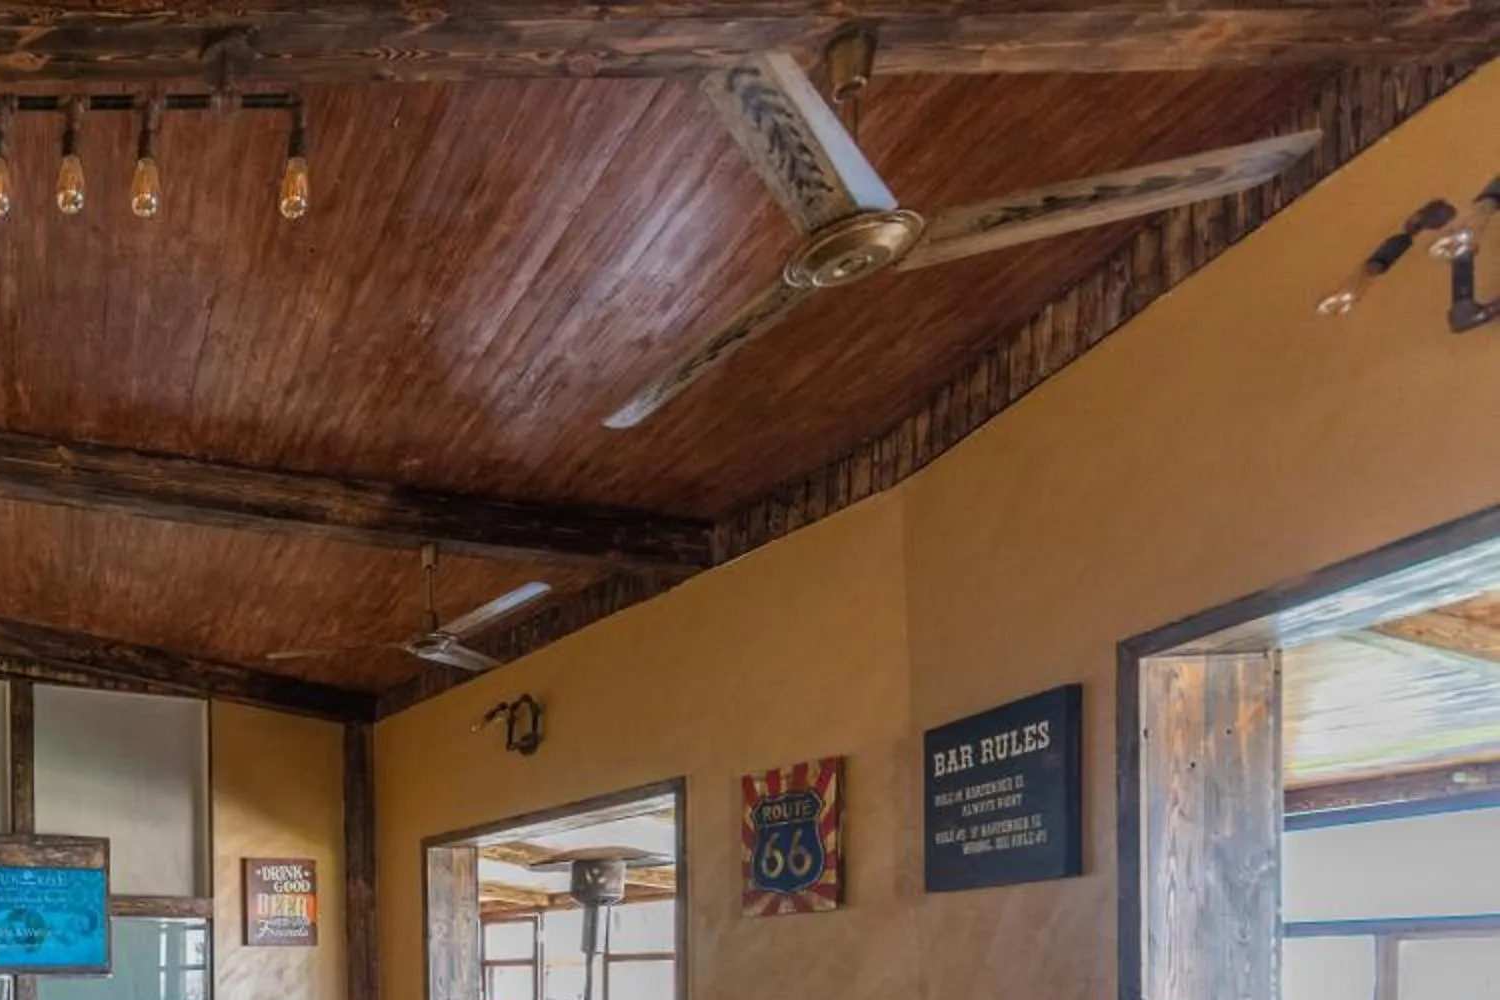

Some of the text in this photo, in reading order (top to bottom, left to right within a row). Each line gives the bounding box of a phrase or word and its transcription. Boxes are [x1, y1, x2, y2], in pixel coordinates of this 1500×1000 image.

[933, 719, 1051, 778] BAR RULES
[762, 799, 813, 822] ROUTE
[761, 829, 813, 879] 66
[262, 865, 303, 881] DRINK
[273, 880, 312, 893] GOOD
